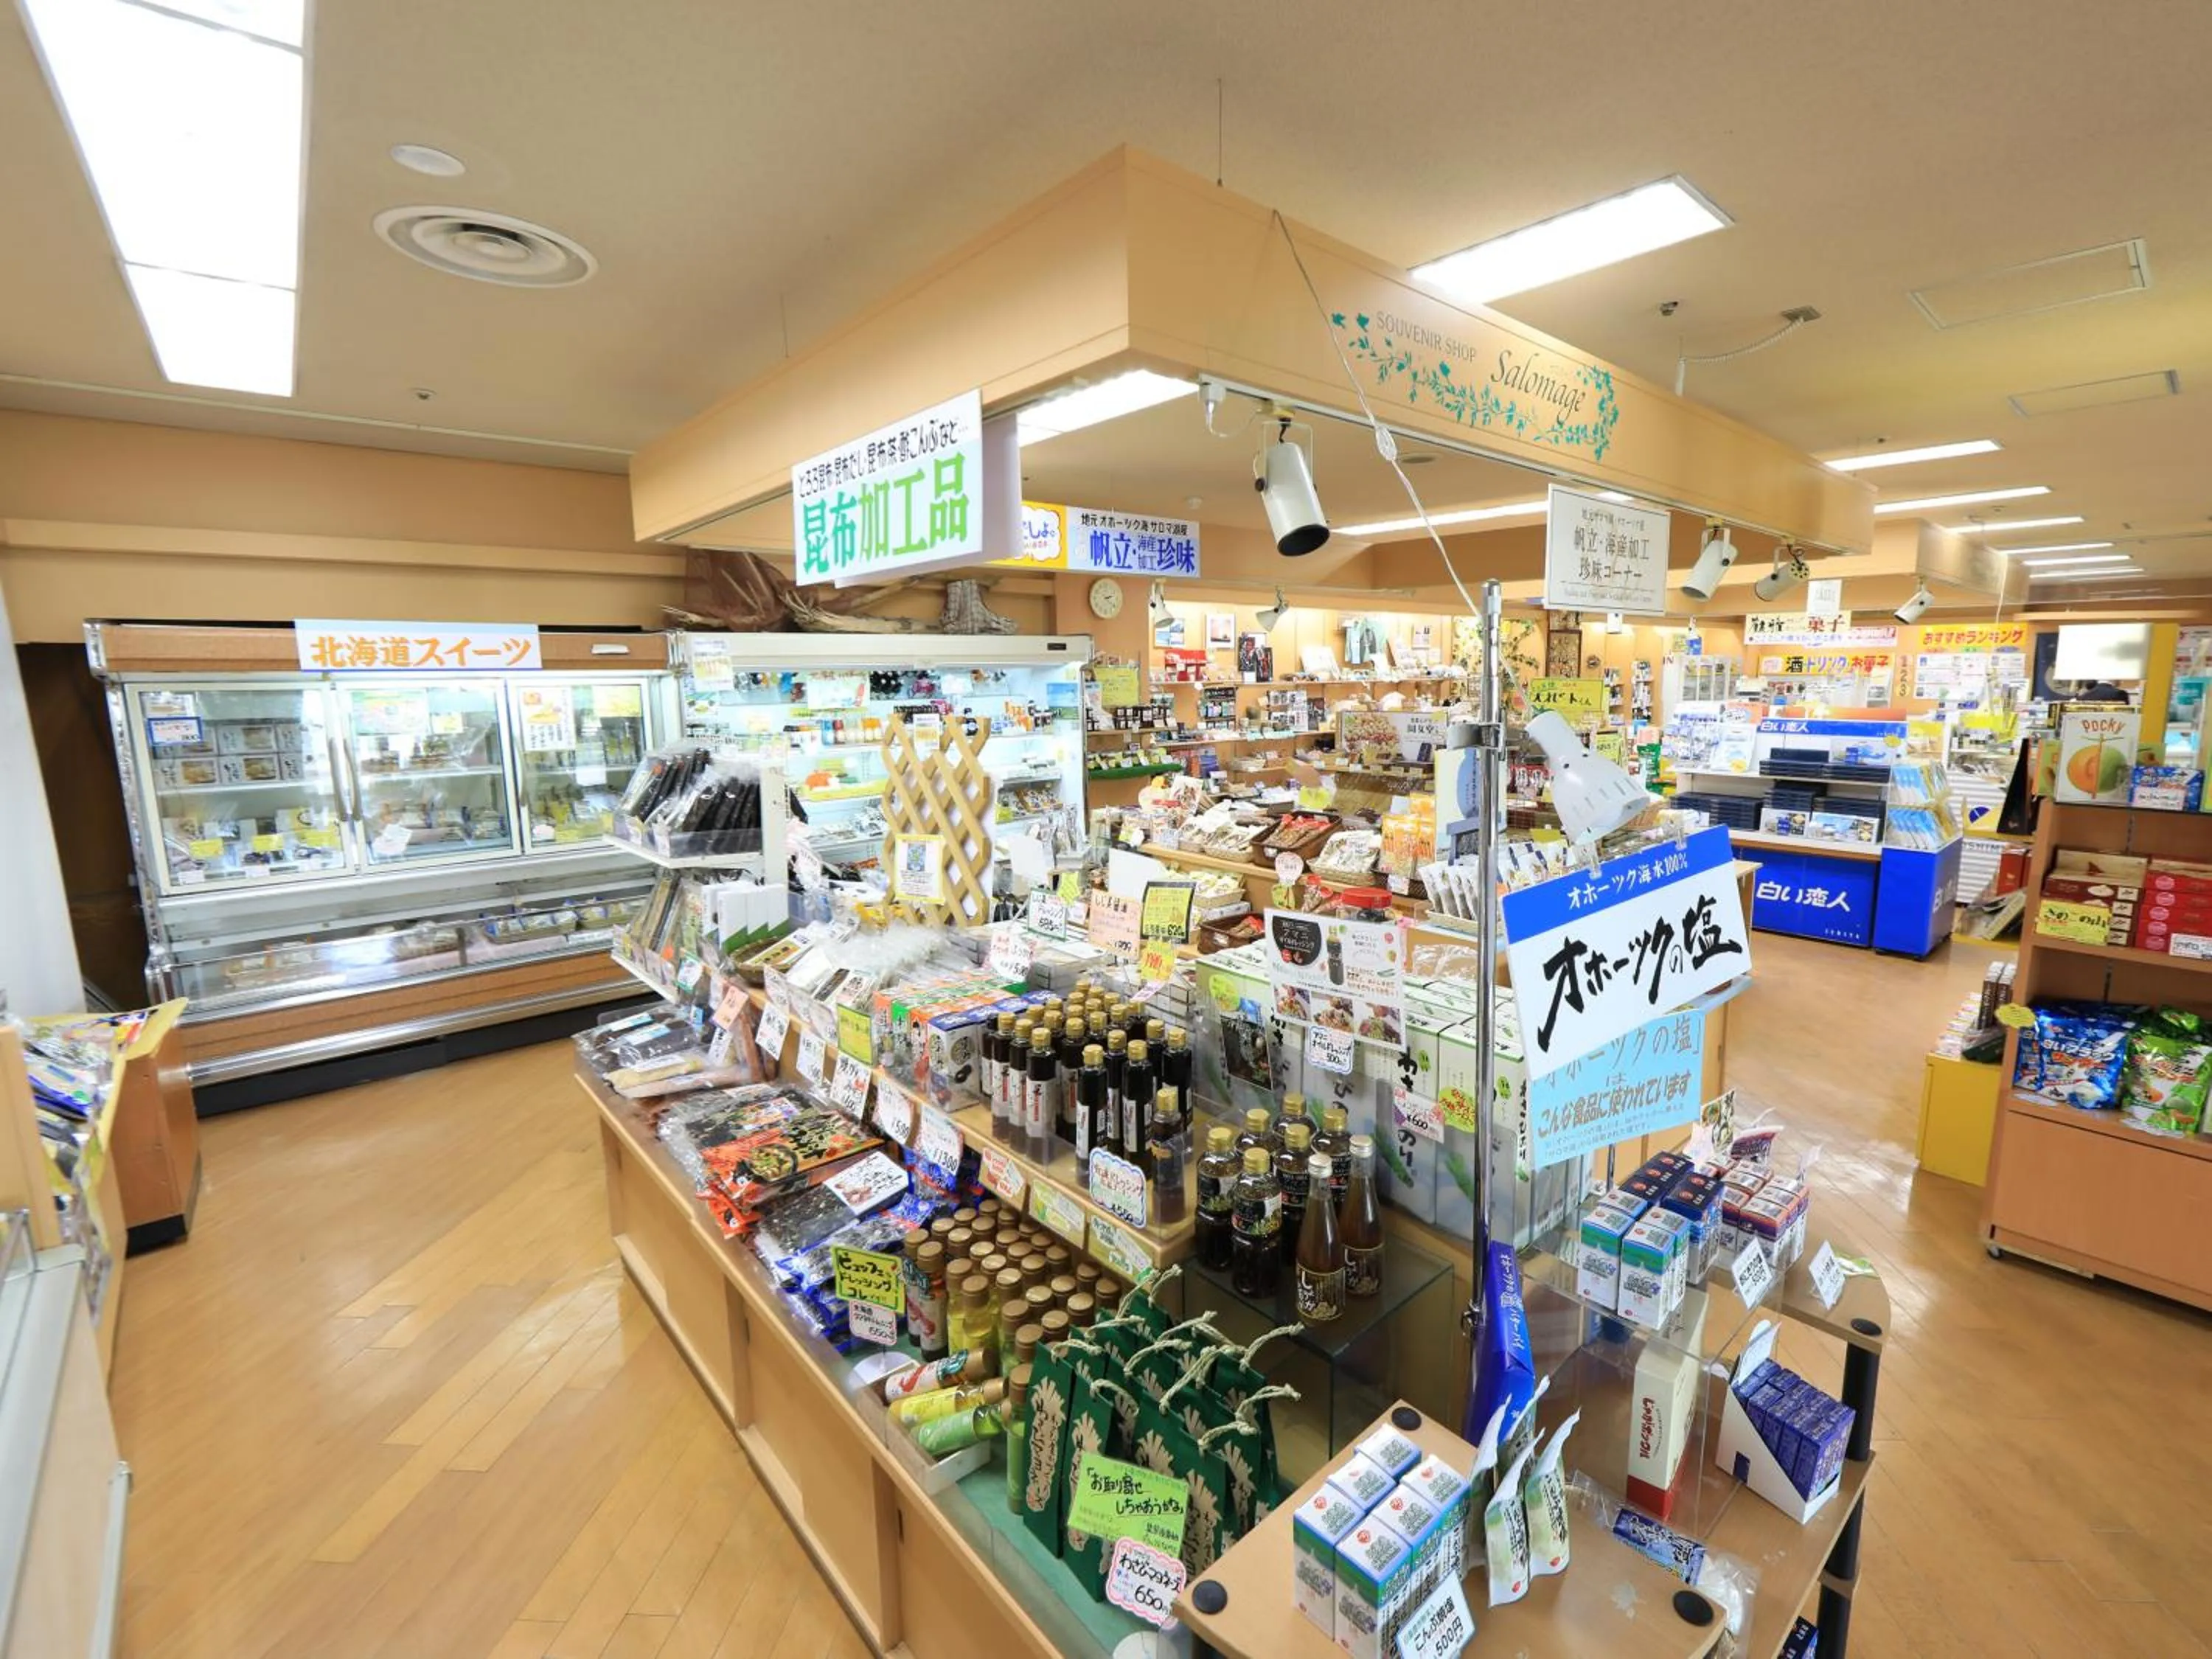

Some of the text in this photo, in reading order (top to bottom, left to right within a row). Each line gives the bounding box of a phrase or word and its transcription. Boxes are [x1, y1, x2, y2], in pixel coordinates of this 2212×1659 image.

[1376, 310, 1475, 361] SOUVENIR SHOP
[1490, 349, 1586, 425] Salomage
[803, 451, 970, 574] 昆布加工品
[310, 636, 532, 668] 北海道スイーツ
[1760, 720, 1809, 732] 白い恋人
[1568, 852, 1688, 910] オホーツク海水100%
[1756, 881, 1851, 913] 白い恋人
[1537, 894, 1742, 1053] オホーツクの塩
[1436, 1615, 1464, 1657] 500円
